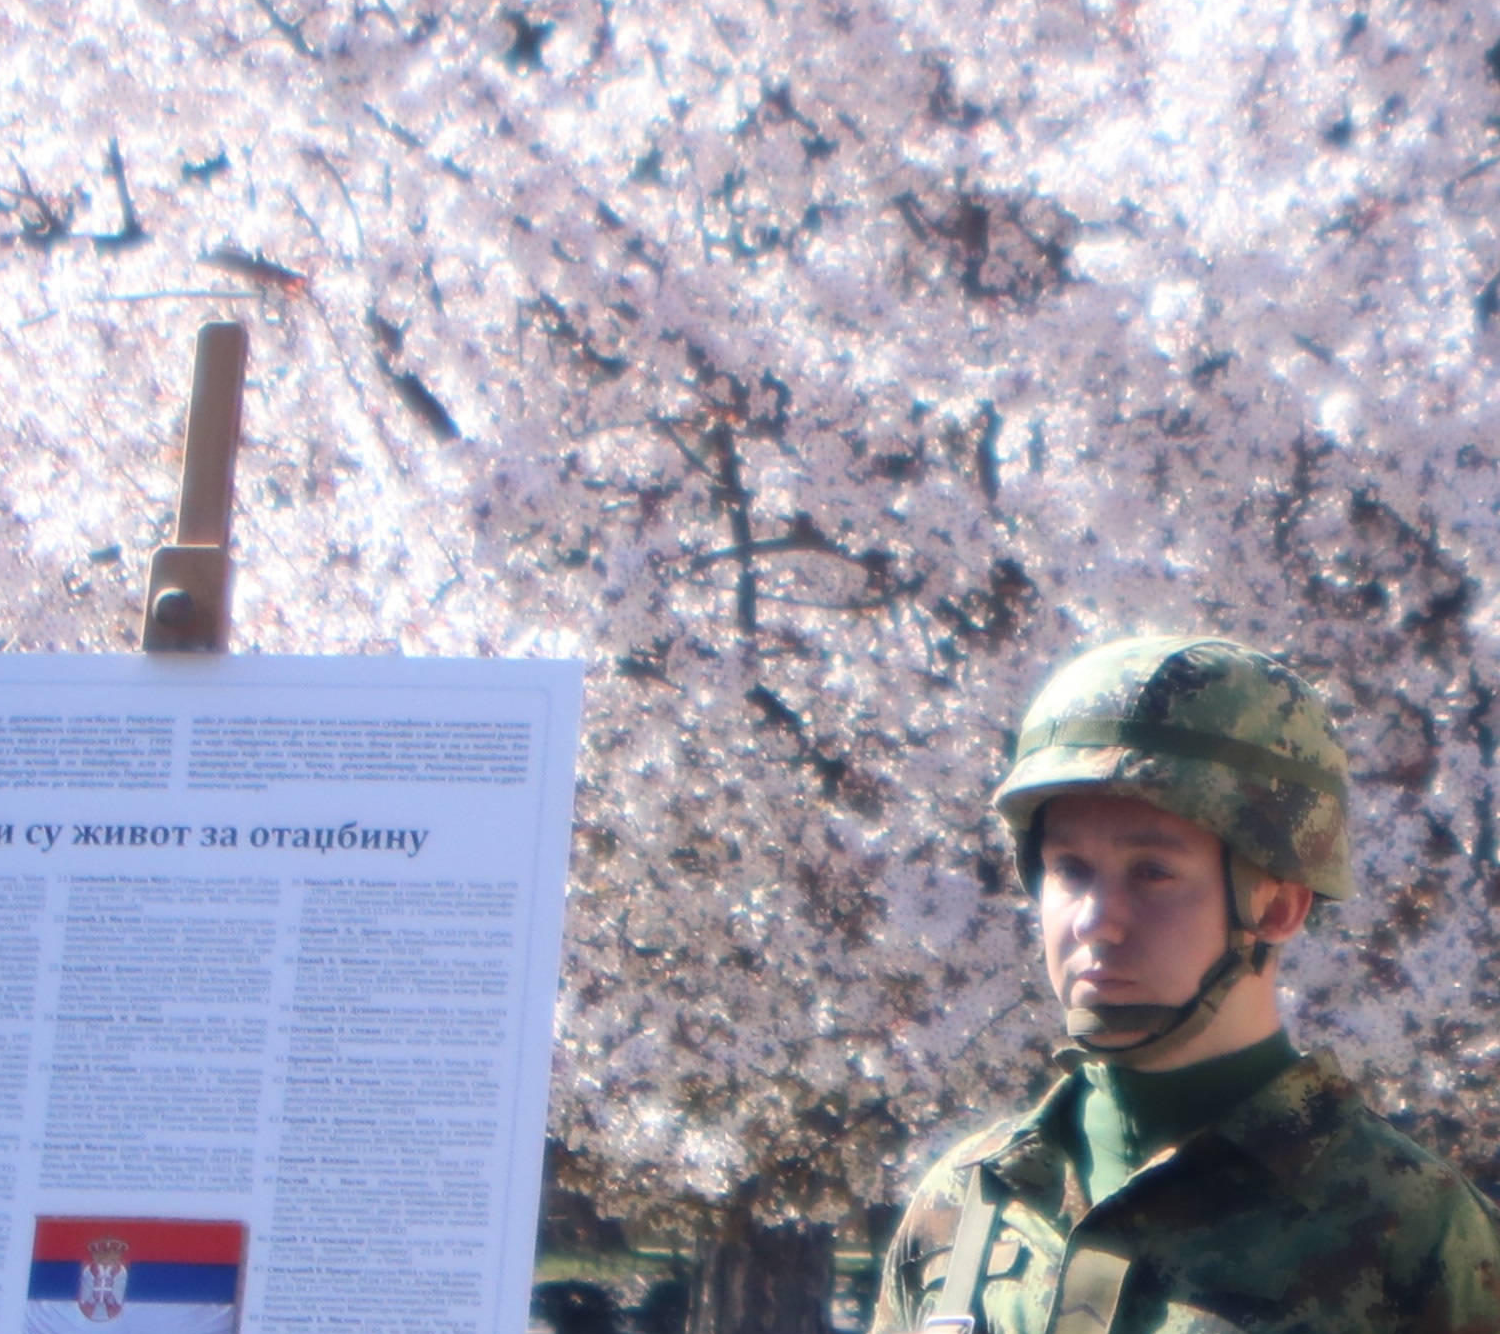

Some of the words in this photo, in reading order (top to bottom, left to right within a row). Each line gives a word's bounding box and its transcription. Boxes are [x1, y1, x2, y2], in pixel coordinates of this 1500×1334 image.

[26, 825, 63, 853] су
[73, 825, 191, 846] живот
[200, 825, 239, 848] за
[250, 821, 431, 857] отаџбину
